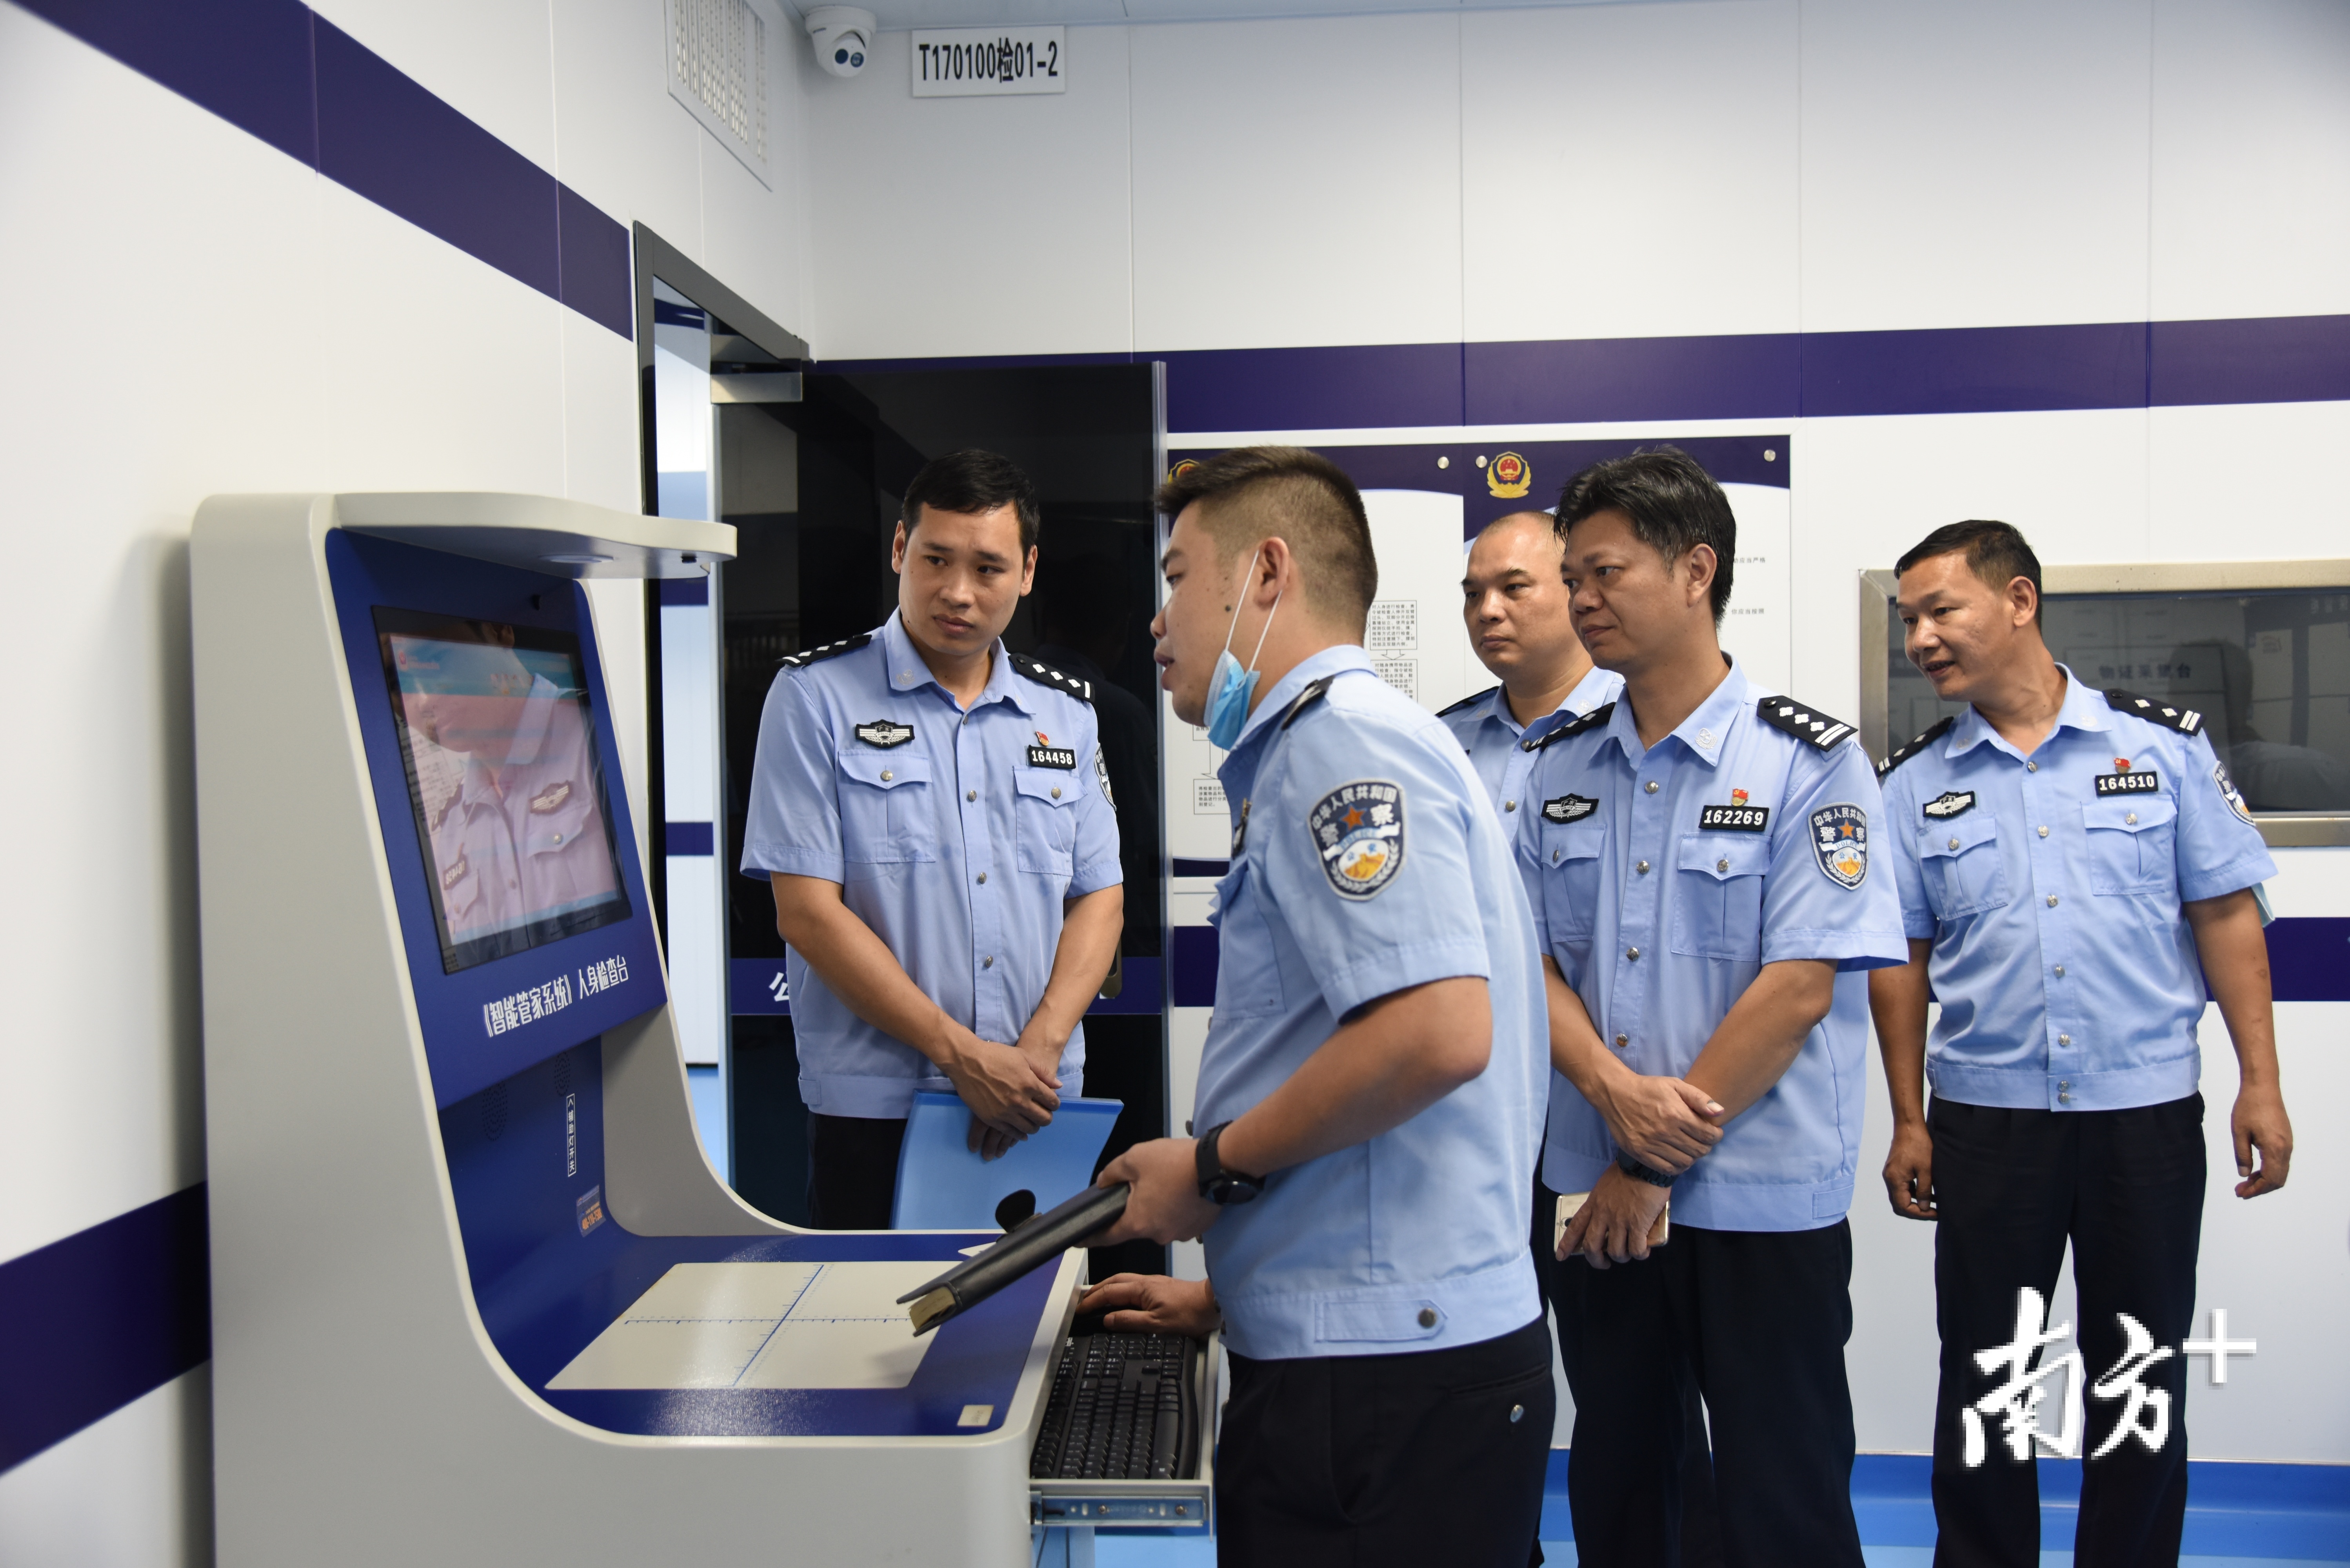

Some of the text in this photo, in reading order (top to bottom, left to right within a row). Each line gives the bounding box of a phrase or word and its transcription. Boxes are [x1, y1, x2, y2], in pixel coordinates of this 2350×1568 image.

[919, 37, 1058, 83] T170100检01-2
[1032, 750, 1072, 765] 164458
[2099, 775, 2155, 791] 164510
[1704, 809, 1764, 826] 162269
[1814, 808, 1866, 827] 中华人民共和国
[1836, 839, 1858, 849] POLICE
[579, 955, 629, 1000] 人身检查台
